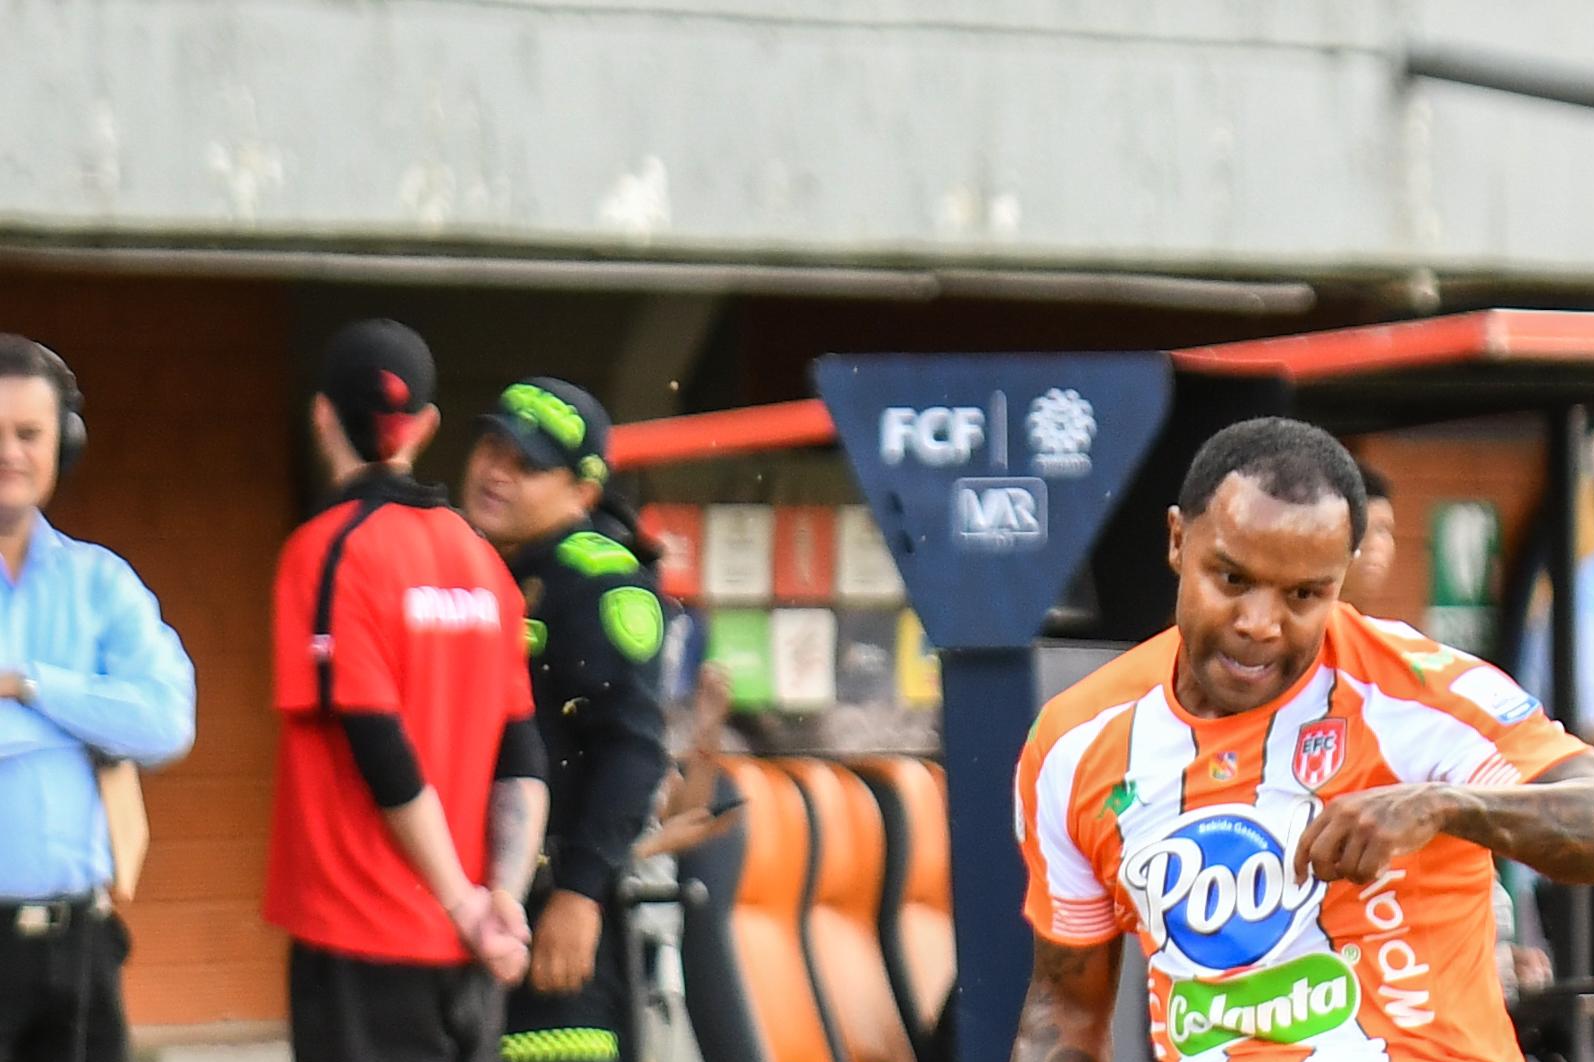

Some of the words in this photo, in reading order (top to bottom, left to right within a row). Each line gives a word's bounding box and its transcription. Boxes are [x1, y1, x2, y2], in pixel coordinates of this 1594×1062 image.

[879, 405, 986, 466] FCF
[959, 486, 1040, 532] VAR
[1302, 735, 1336, 754] EFC
[1358, 868, 1436, 1029] Wplay
[1169, 974, 1348, 1044] Colanta
